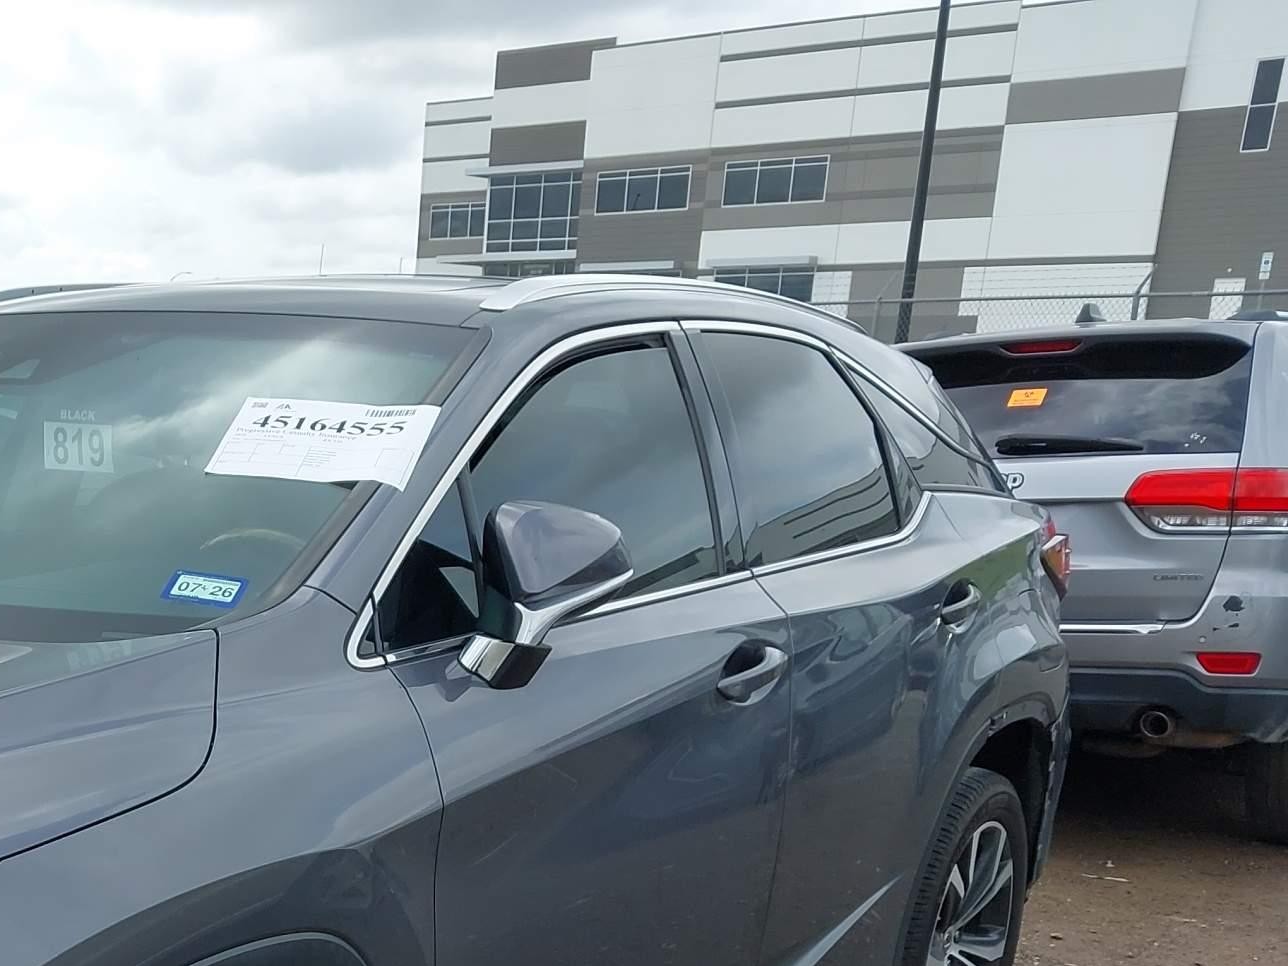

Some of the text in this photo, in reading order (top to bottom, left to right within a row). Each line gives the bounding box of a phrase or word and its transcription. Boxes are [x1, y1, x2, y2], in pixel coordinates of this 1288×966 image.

[252, 413, 408, 438] 45164555
[53, 427, 105, 467] 819
[177, 581, 235, 598] 07 26
